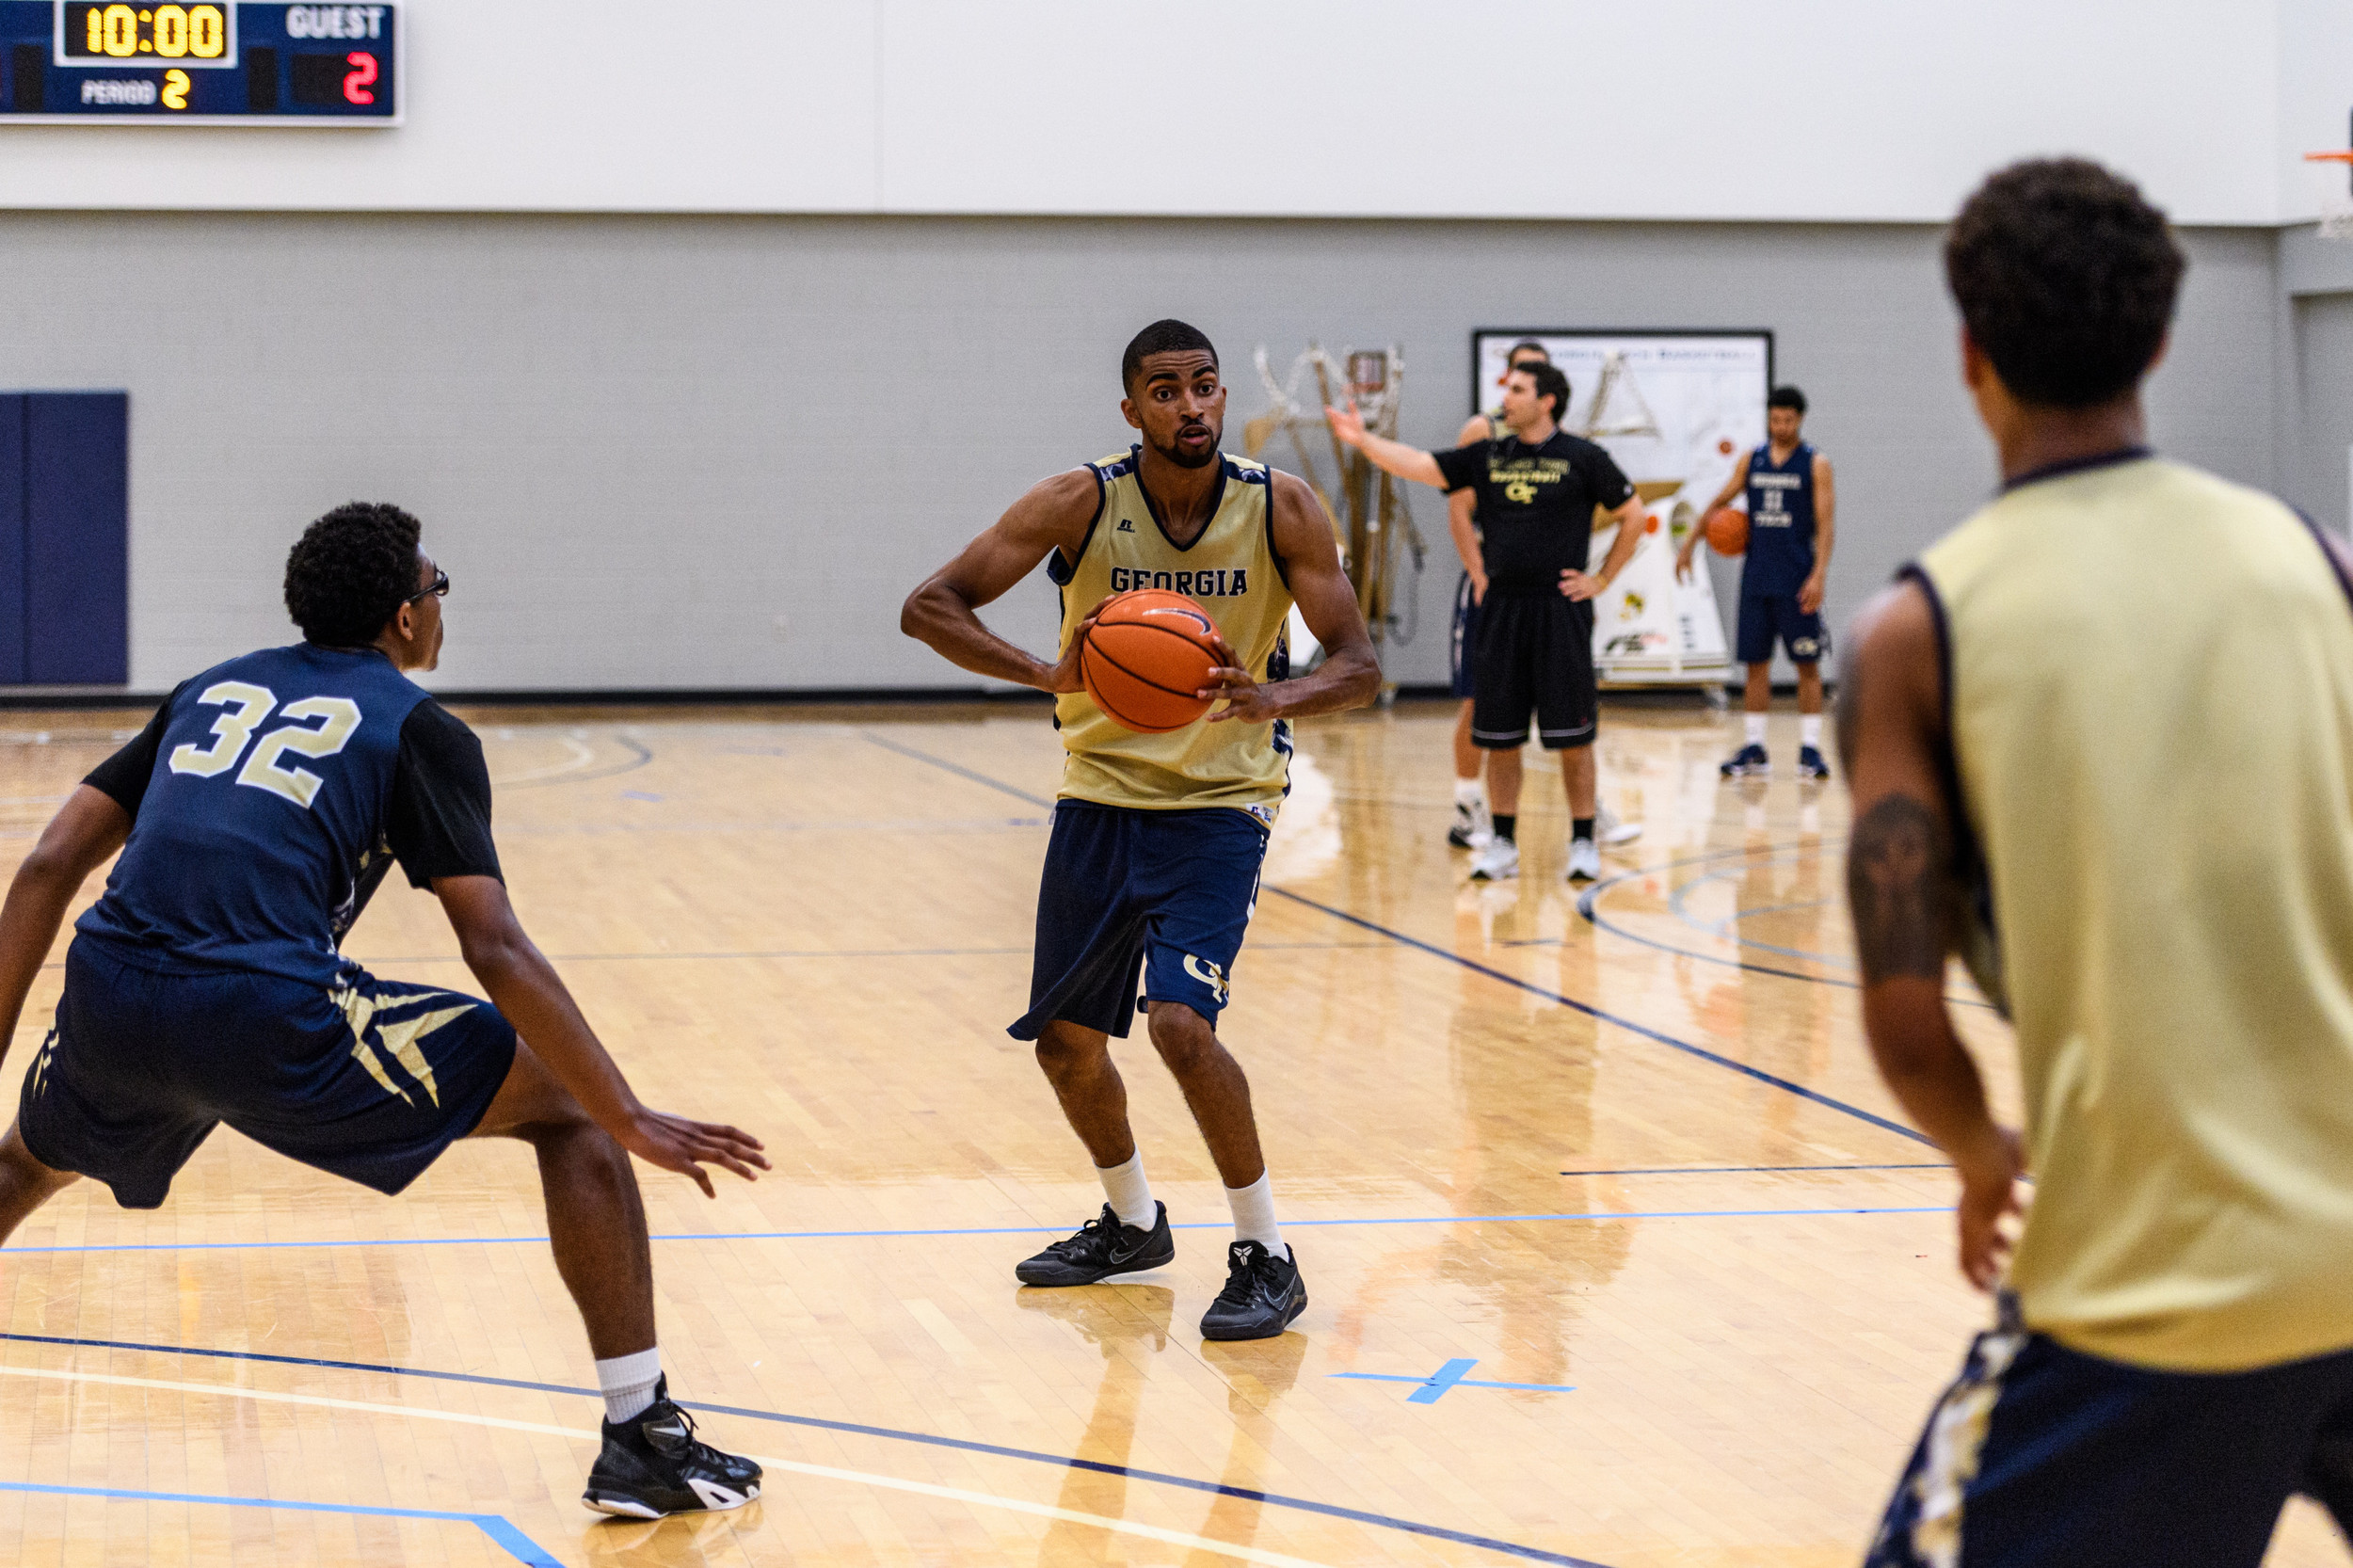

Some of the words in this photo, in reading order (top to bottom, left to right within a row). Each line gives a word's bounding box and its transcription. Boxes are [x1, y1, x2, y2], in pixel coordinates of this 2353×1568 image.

[87, 4, 223, 57] 10:00
[286, 6, 385, 39] GUEST
[81, 80, 157, 104] PERIOD
[162, 69, 191, 109] 2
[344, 52, 377, 104] 2
[1111, 567, 1248, 597] GEORGIA
[168, 680, 362, 809] 32
